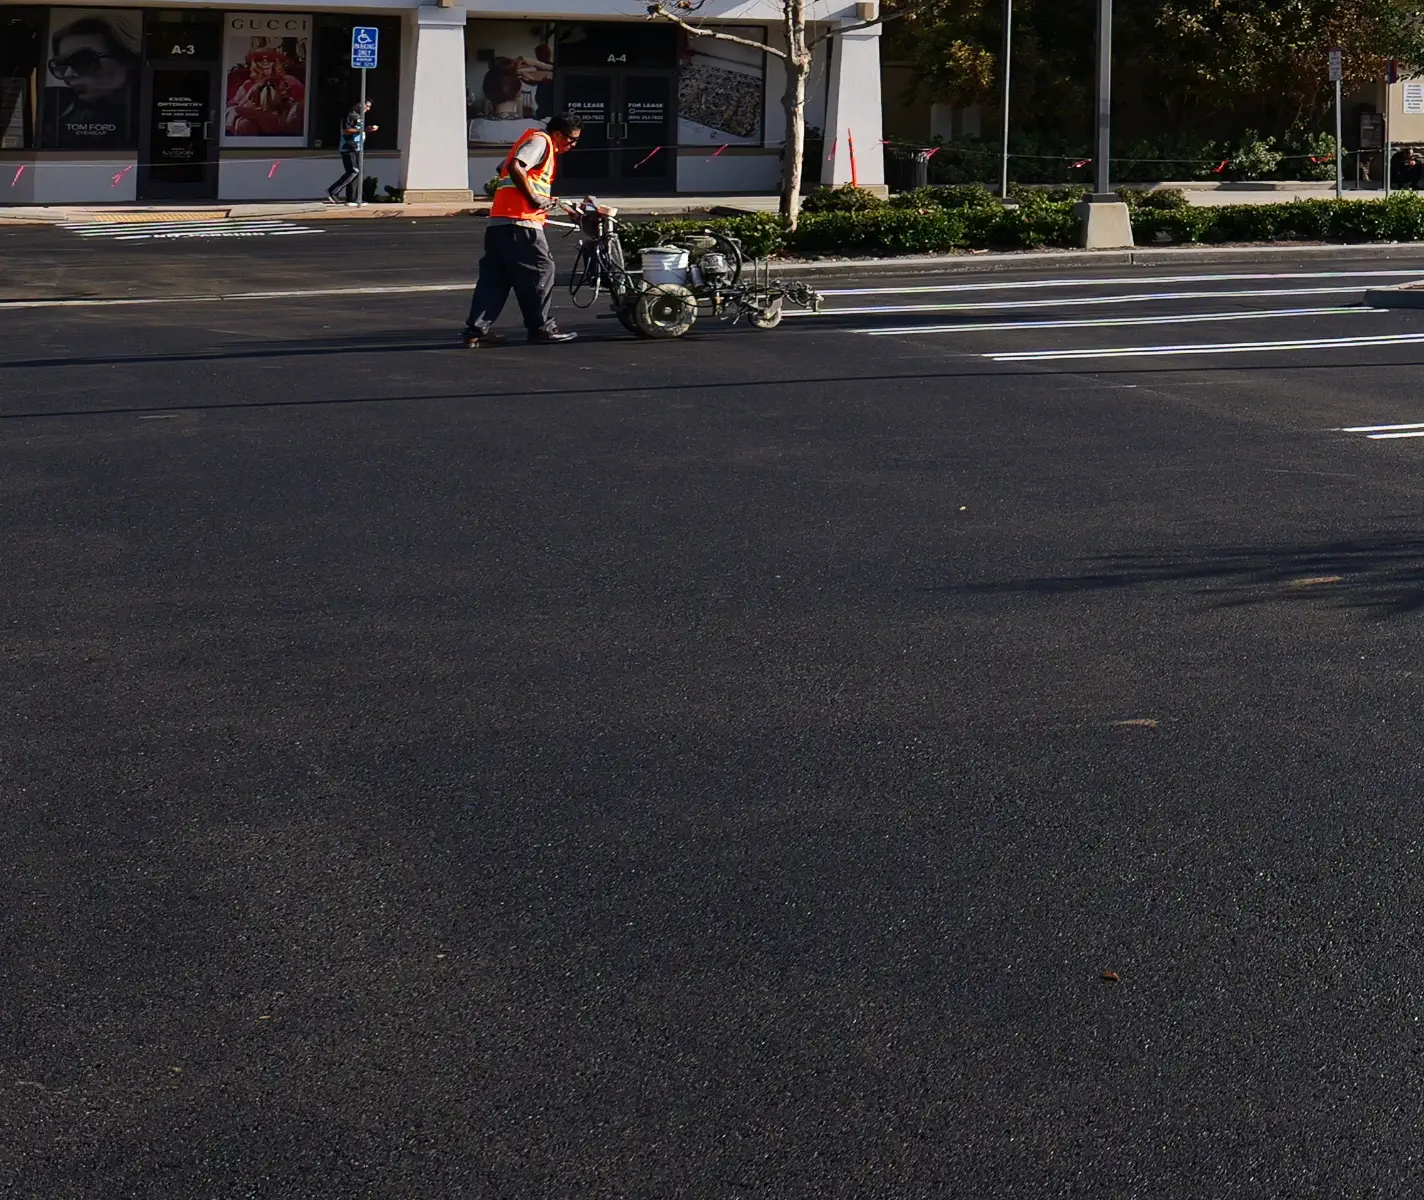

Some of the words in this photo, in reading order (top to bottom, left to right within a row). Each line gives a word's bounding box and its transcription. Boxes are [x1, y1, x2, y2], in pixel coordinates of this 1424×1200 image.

[231, 18, 307, 31] GUCCI
[171, 44, 196, 55] A-3
[607, 53, 627, 63] A-4
[65, 123, 88, 131] TOM
[88, 123, 117, 131] FORD
